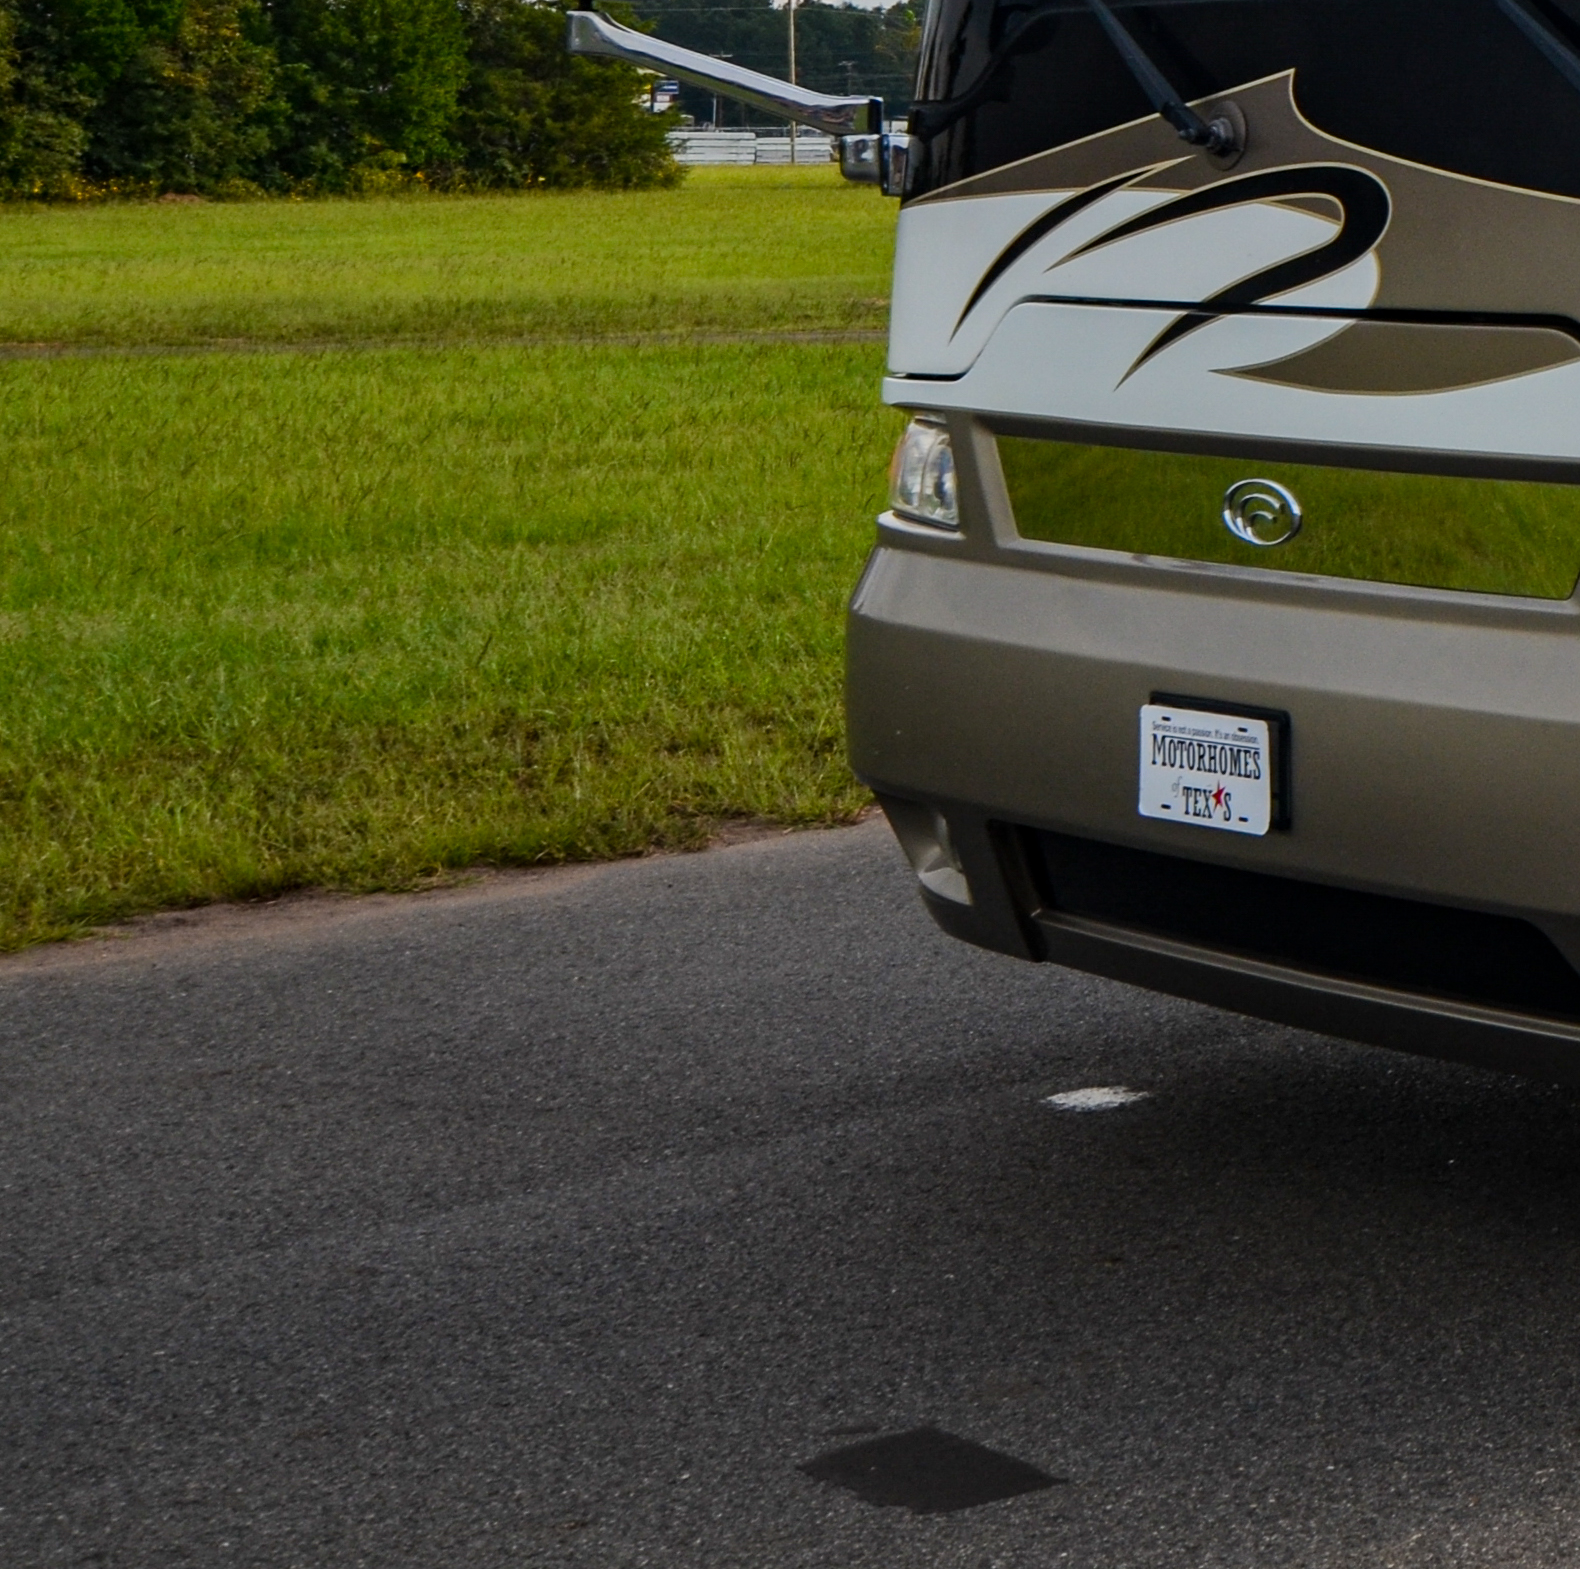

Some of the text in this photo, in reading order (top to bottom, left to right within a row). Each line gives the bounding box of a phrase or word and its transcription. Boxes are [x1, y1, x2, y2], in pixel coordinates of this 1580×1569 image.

[1151, 733, 1261, 780] MOTORHOMES
[1171, 776, 1232, 822] of TEXS
